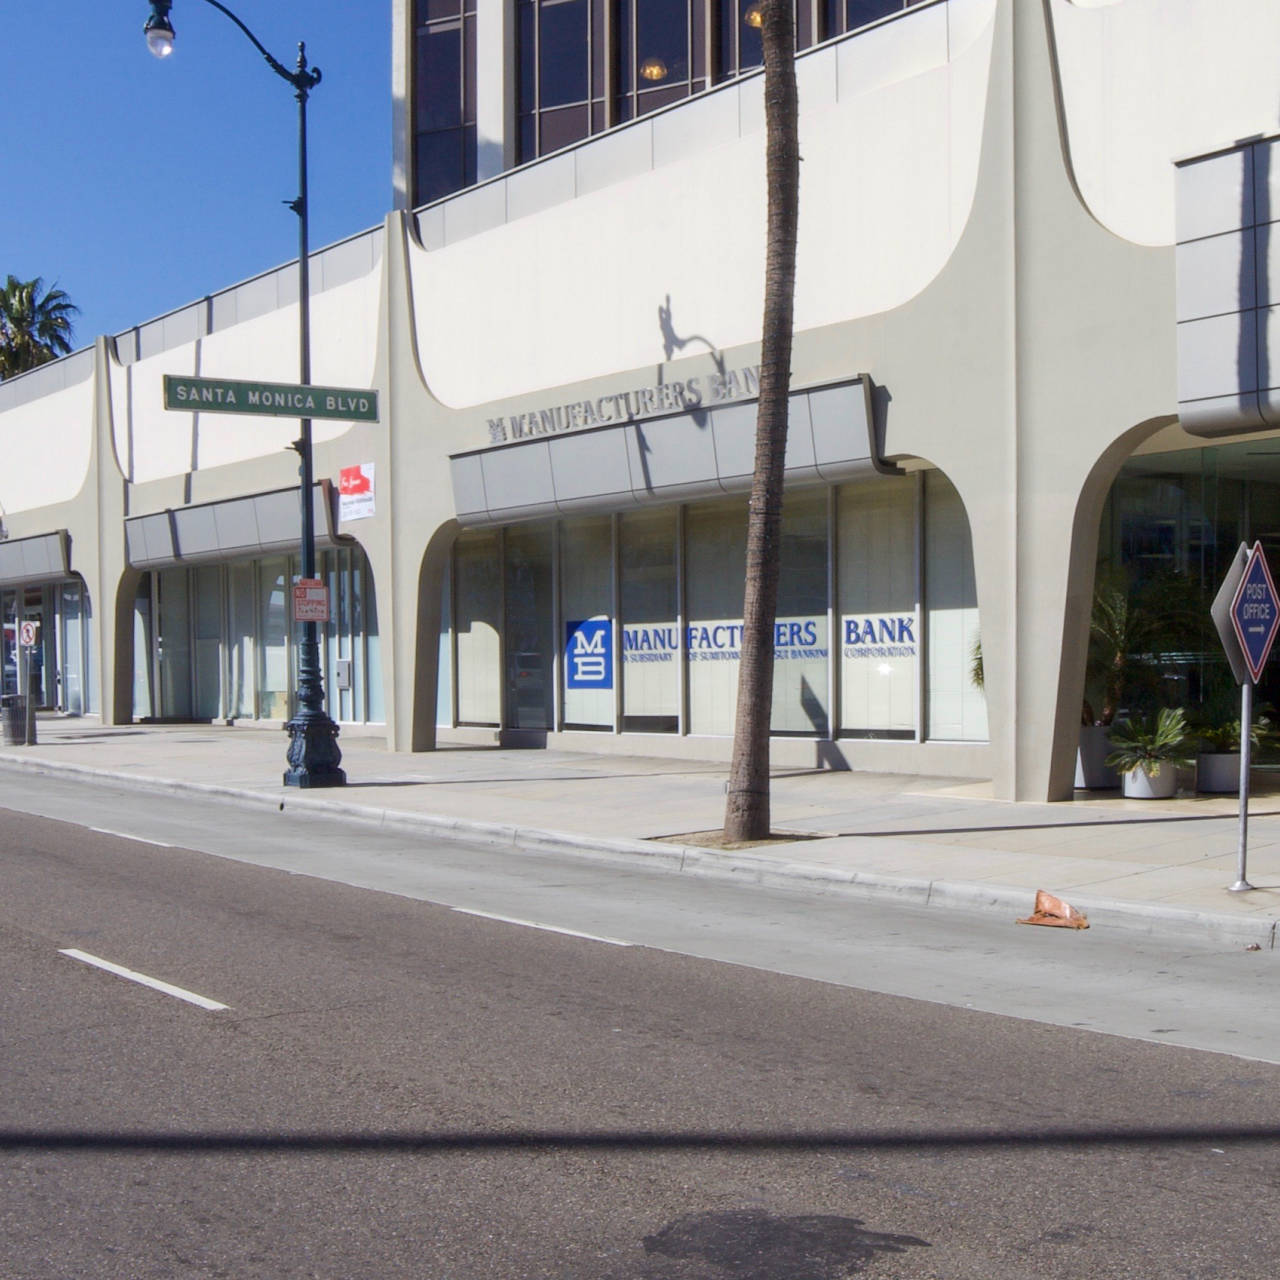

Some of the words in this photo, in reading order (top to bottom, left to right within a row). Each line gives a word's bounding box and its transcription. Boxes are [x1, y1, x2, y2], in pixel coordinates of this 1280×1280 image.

[176, 385, 237, 404] SANTA
[247, 390, 316, 409] MONICA
[326, 396, 369, 412] BLVD
[509, 378, 702, 440] MANUFACTURERS
[706, 365, 762, 400] BAN
[1246, 583, 1267, 600] POST
[1243, 603, 1270, 620] OFFICE
[844, 617, 915, 645] BANK
